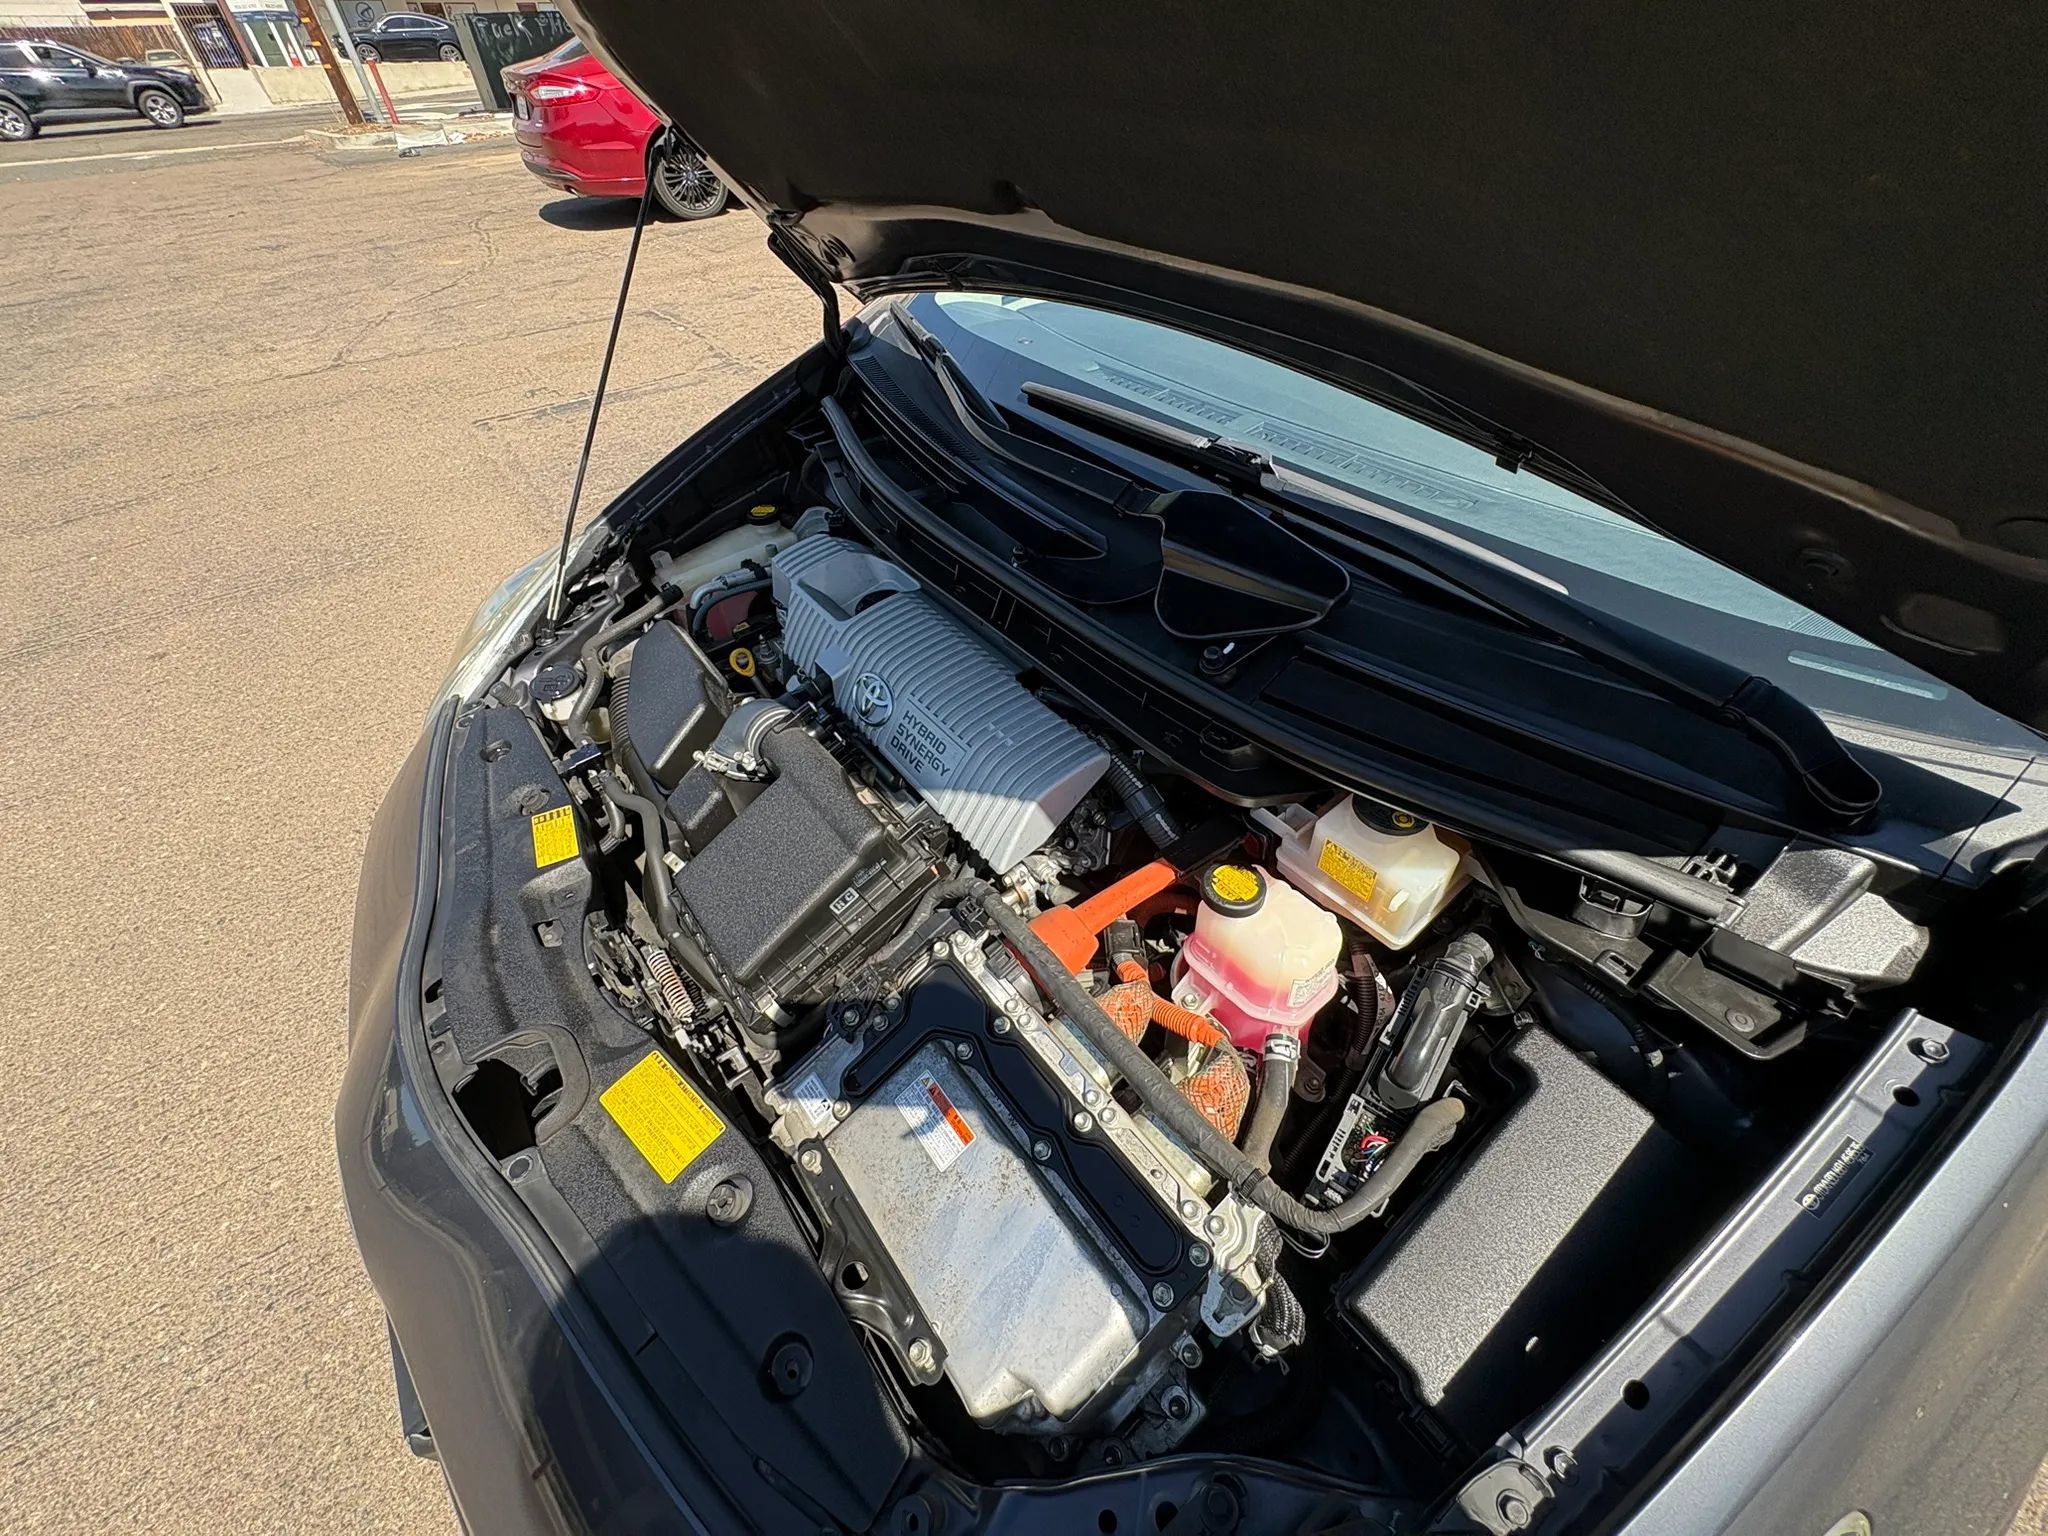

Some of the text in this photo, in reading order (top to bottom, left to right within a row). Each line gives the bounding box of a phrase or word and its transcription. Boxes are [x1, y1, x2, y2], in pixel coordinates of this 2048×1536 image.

[891, 735, 924, 773] DRIVE
[896, 723, 950, 776] SYNERGY
[903, 710, 947, 755] HYBRID
